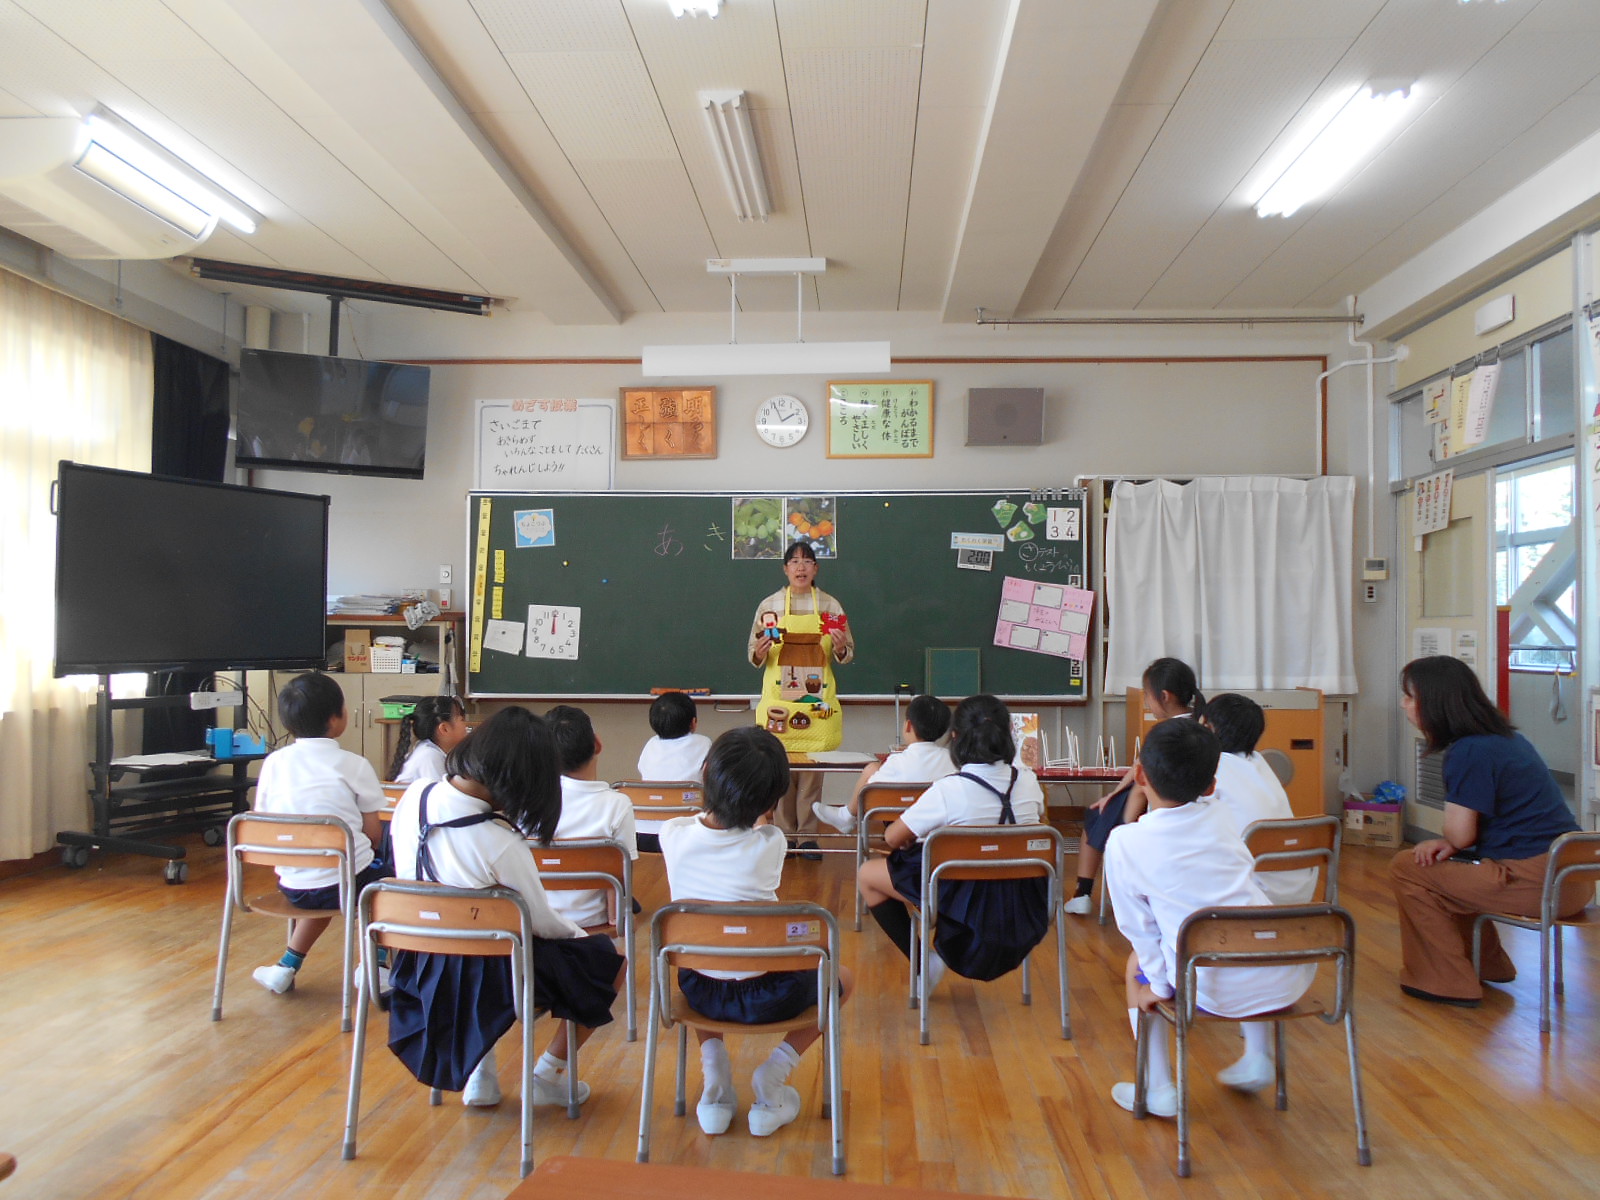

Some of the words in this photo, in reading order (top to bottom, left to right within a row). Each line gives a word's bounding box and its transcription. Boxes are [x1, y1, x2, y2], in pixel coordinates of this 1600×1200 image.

[489, 419, 542, 432] さいごまで
[496, 434, 537, 446] あきらめず
[1053, 510, 1057, 522] 1
[1066, 510, 1075, 523] 2
[1050, 526, 1059, 538] 3
[1066, 526, 1075, 538] 4
[654, 522, 683, 556] あ
[704, 522, 726, 551] き
[543, 611, 550, 619] 11
[535, 618, 543, 627] 10
[568, 620, 574, 628] 2
[532, 627, 538, 635] 9
[570, 630, 576, 638] 3
[541, 643, 546, 651] 7
[558, 645, 564, 653] 5
[470, 907, 480, 920] 7
[791, 926, 799, 934] 2
